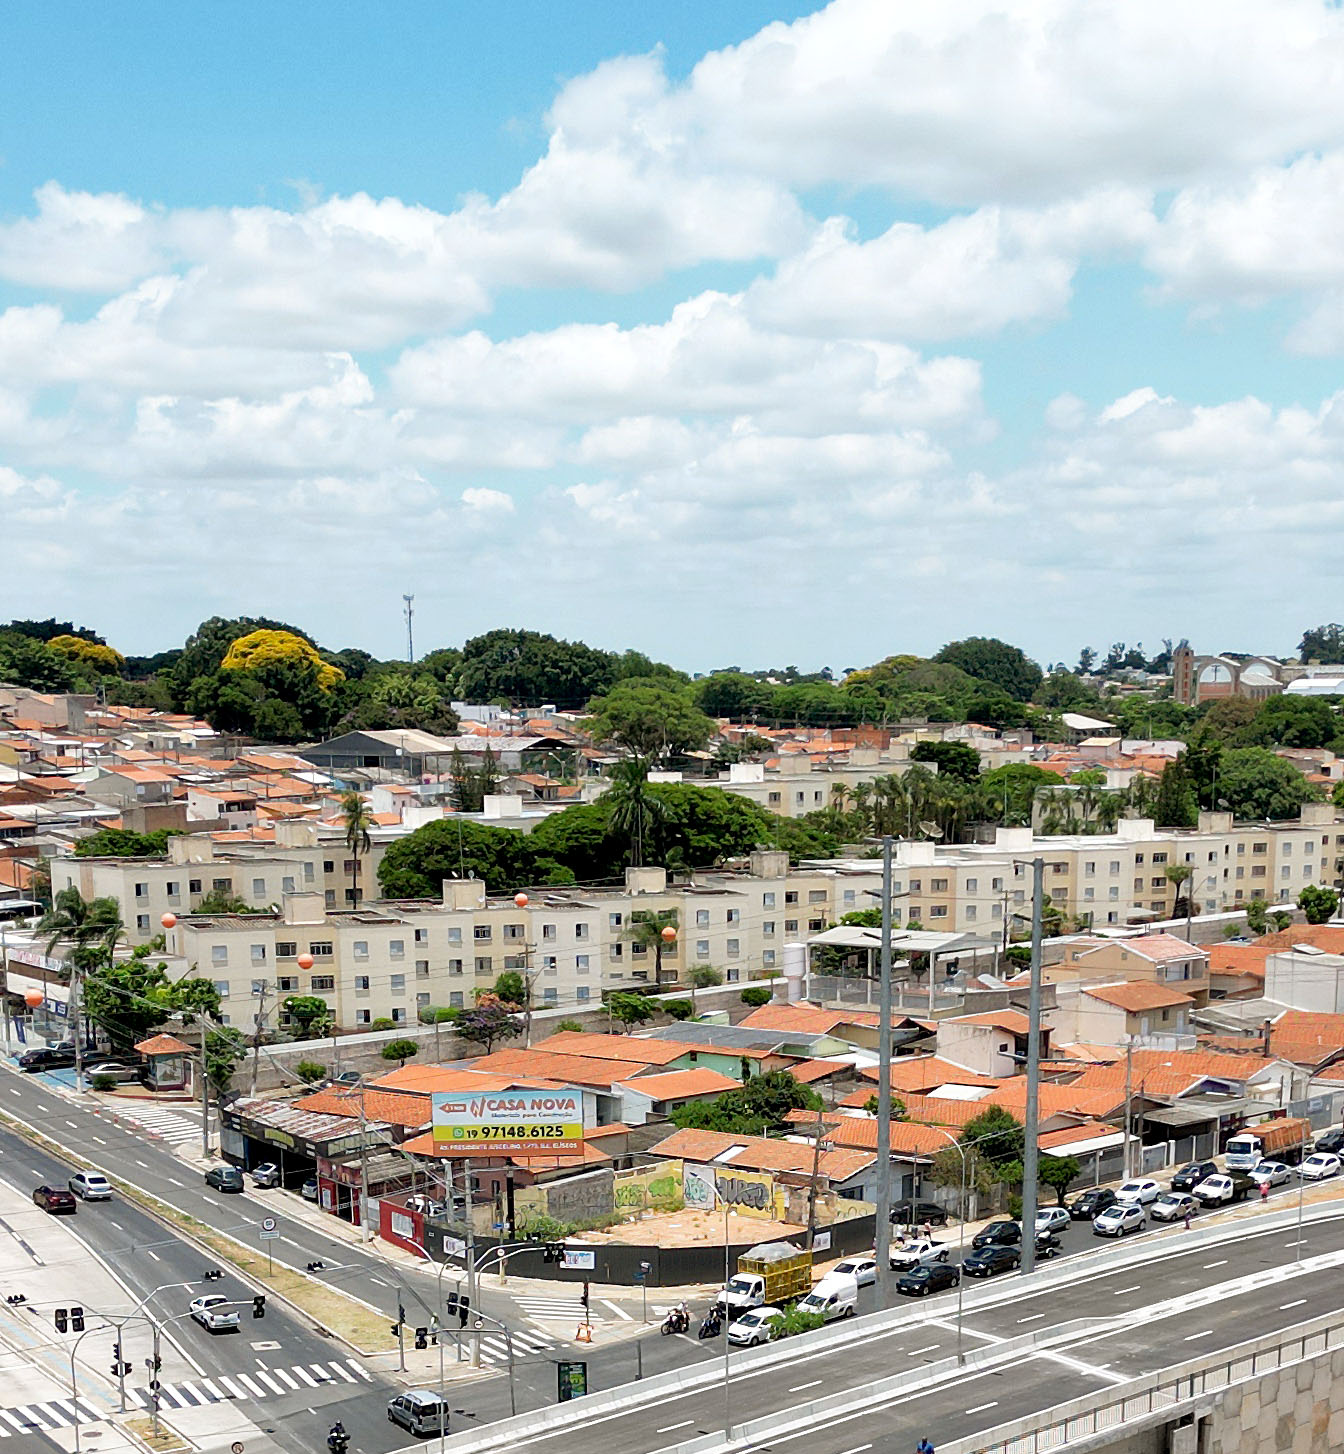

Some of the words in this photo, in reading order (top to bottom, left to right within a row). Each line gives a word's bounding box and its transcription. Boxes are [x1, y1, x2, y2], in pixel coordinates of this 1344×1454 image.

[487, 1098, 526, 1111] CASA
[531, 1098, 576, 1111] NOVA
[467, 1129, 478, 1139] 19
[482, 1125, 564, 1138] 97148.6125
